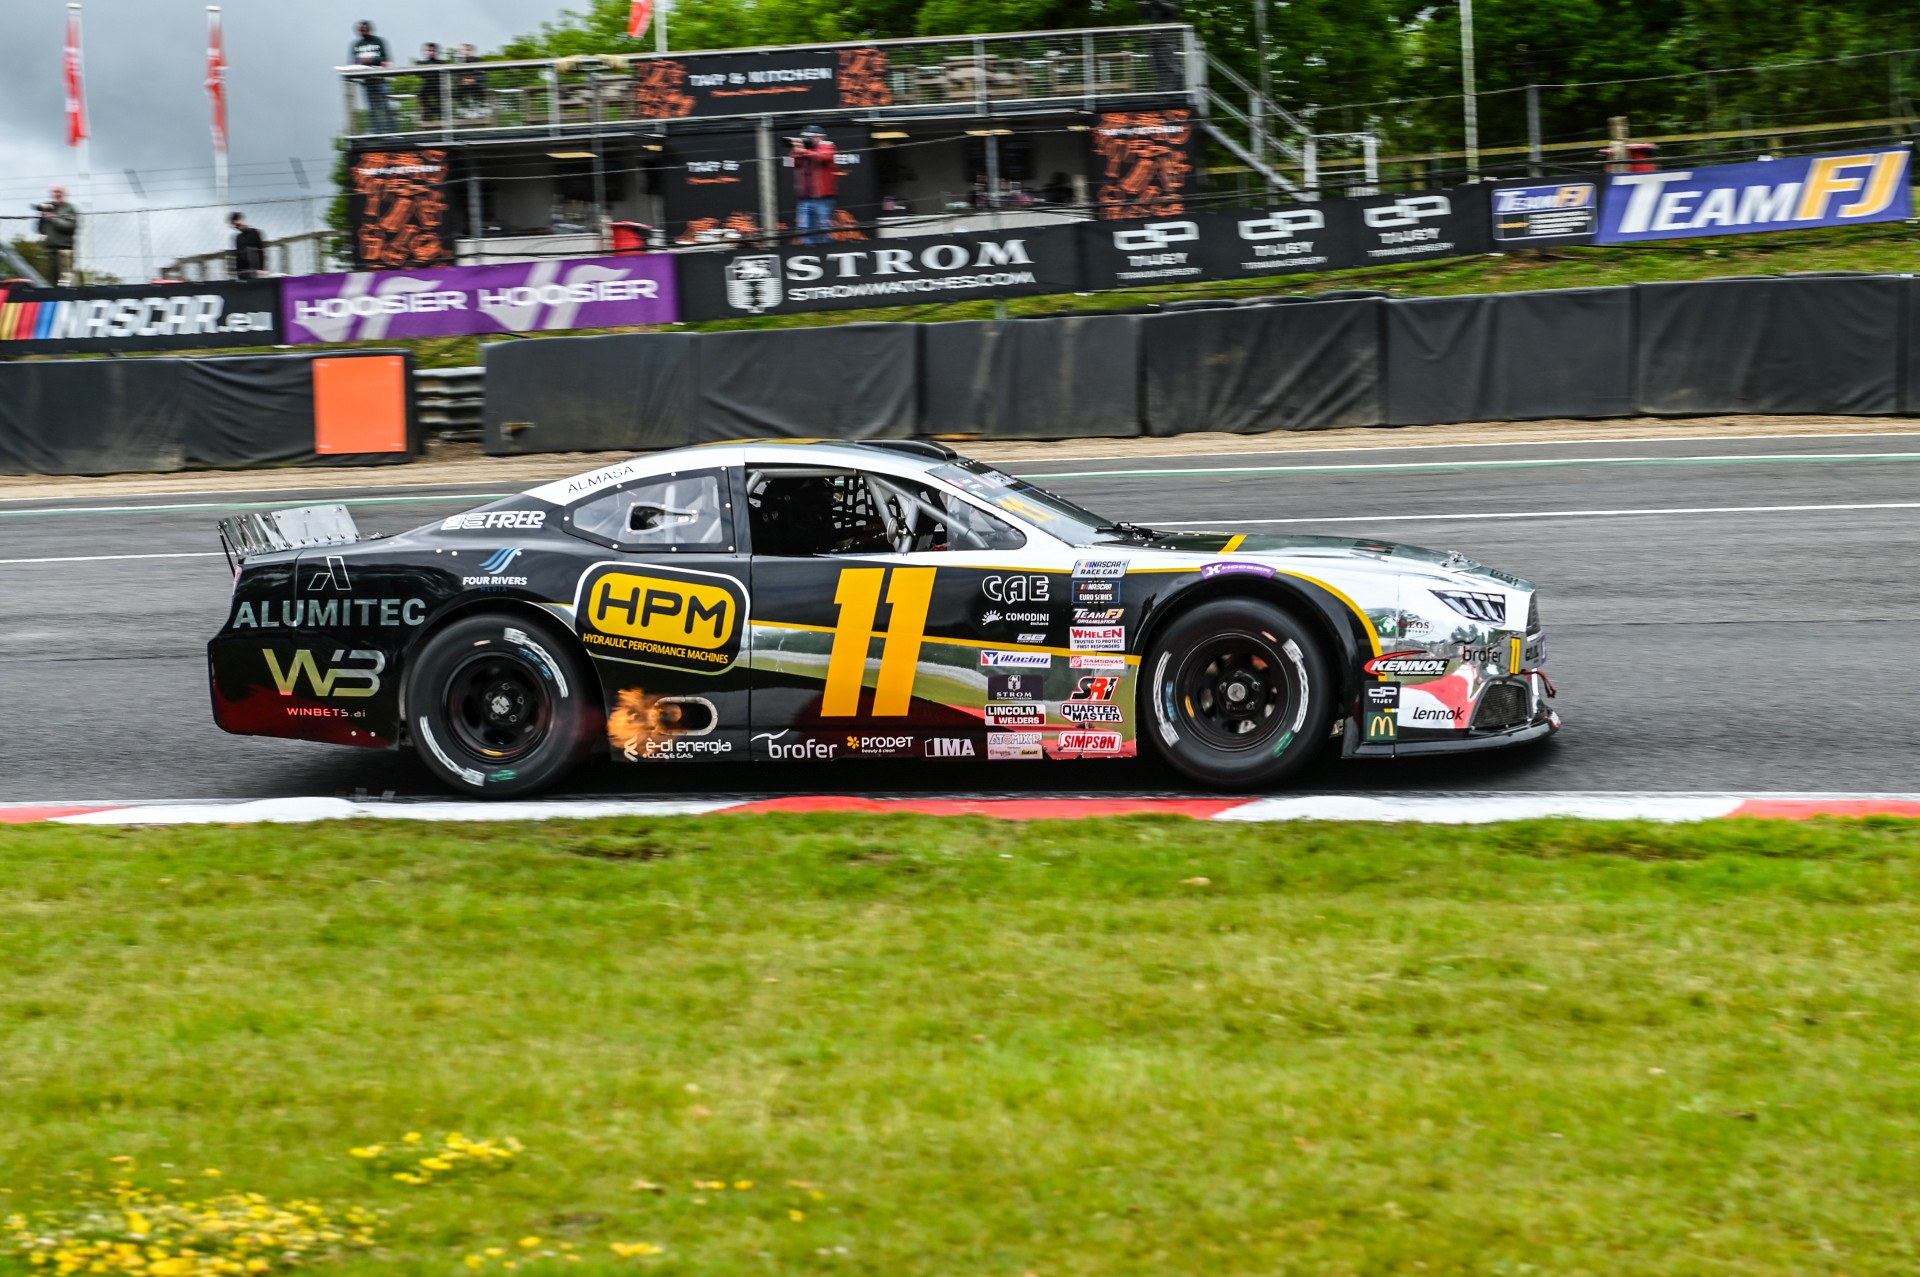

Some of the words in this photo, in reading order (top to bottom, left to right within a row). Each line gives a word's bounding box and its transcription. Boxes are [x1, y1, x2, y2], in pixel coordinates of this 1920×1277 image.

[786, 239, 1035, 280] STROM
[477, 279, 659, 310] HOOSIER
[295, 290, 468, 320] HOOSIER
[49, 295, 273, 339] NASCAR.eu
[568, 466, 634, 494] ALMASA
[462, 576, 490, 586] FOUR
[491, 576, 528, 586] RIVERS
[982, 575, 1050, 605] CAE
[1079, 593, 1094, 601] EURO
[1094, 593, 1113, 601] SERIES
[232, 598, 426, 629] ALUMITEC
[597, 582, 727, 639] HPM
[1005, 612, 1050, 622] COMODINI
[1071, 628, 1123, 639] WHELEN
[582, 633, 628, 649] HYDRAULIC
[628, 640, 686, 658] PERFORMANCE
[687, 650, 729, 664] MACHINES
[821, 567, 937, 717] 11
[1000, 655, 1049, 664] iRacing
[1463, 646, 1503, 662] brofer
[1370, 660, 1445, 671] KENNOL
[287, 707, 365, 718] WINBETS.ai
[988, 706, 1035, 716] LINCOLN
[1062, 704, 1118, 716] QUARTER
[1072, 712, 1120, 721] MASTER
[1413, 707, 1464, 720] lennok
[998, 716, 1040, 724] WELDERS
[676, 739, 732, 755] energia
[767, 738, 838, 759] brofer
[933, 737, 976, 757] IMA
[1063, 735, 1117, 749] SIMPSON
